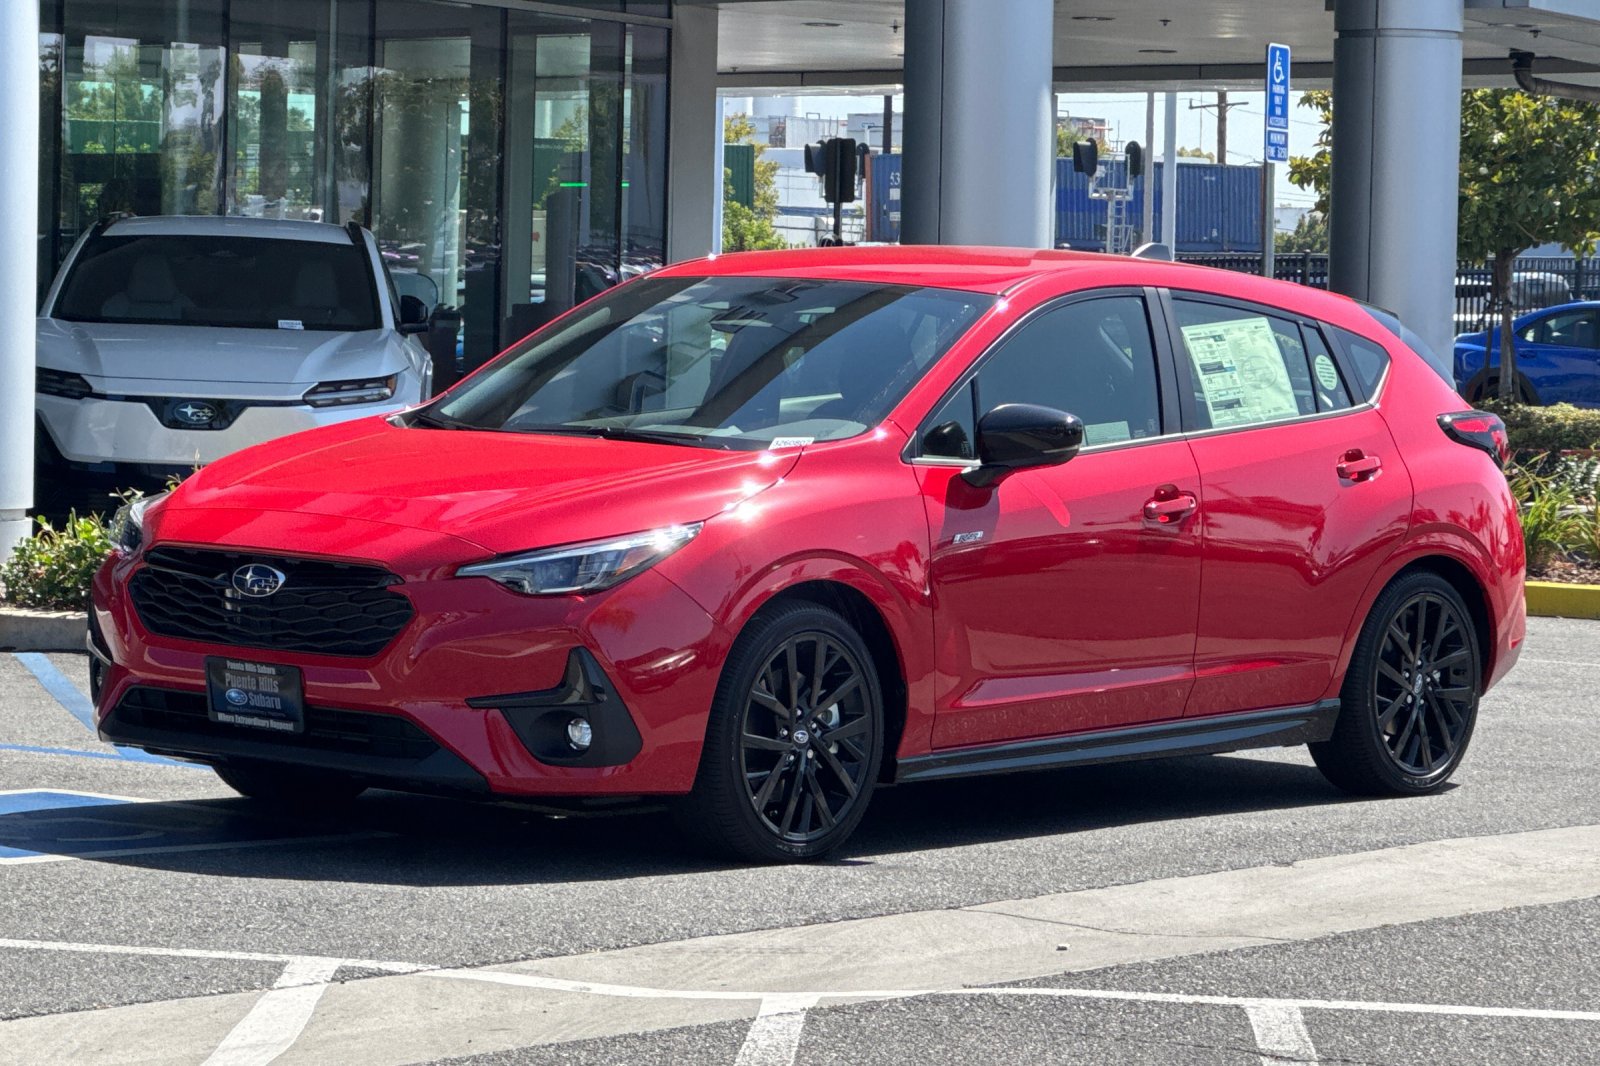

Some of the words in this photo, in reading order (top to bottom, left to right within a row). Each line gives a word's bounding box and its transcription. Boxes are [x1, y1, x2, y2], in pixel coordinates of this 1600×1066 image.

[890, 172, 900, 186] 53
[226, 660, 244, 671] Puente
[245, 662, 257, 673] Hills
[257, 664, 276, 675] Subaru
[225, 673, 256, 690] Puente
[258, 676, 279, 693] Hills
[248, 692, 281, 710] Subaru
[217, 712, 235, 723] Where
[235, 714, 269, 728] Extraordinary
